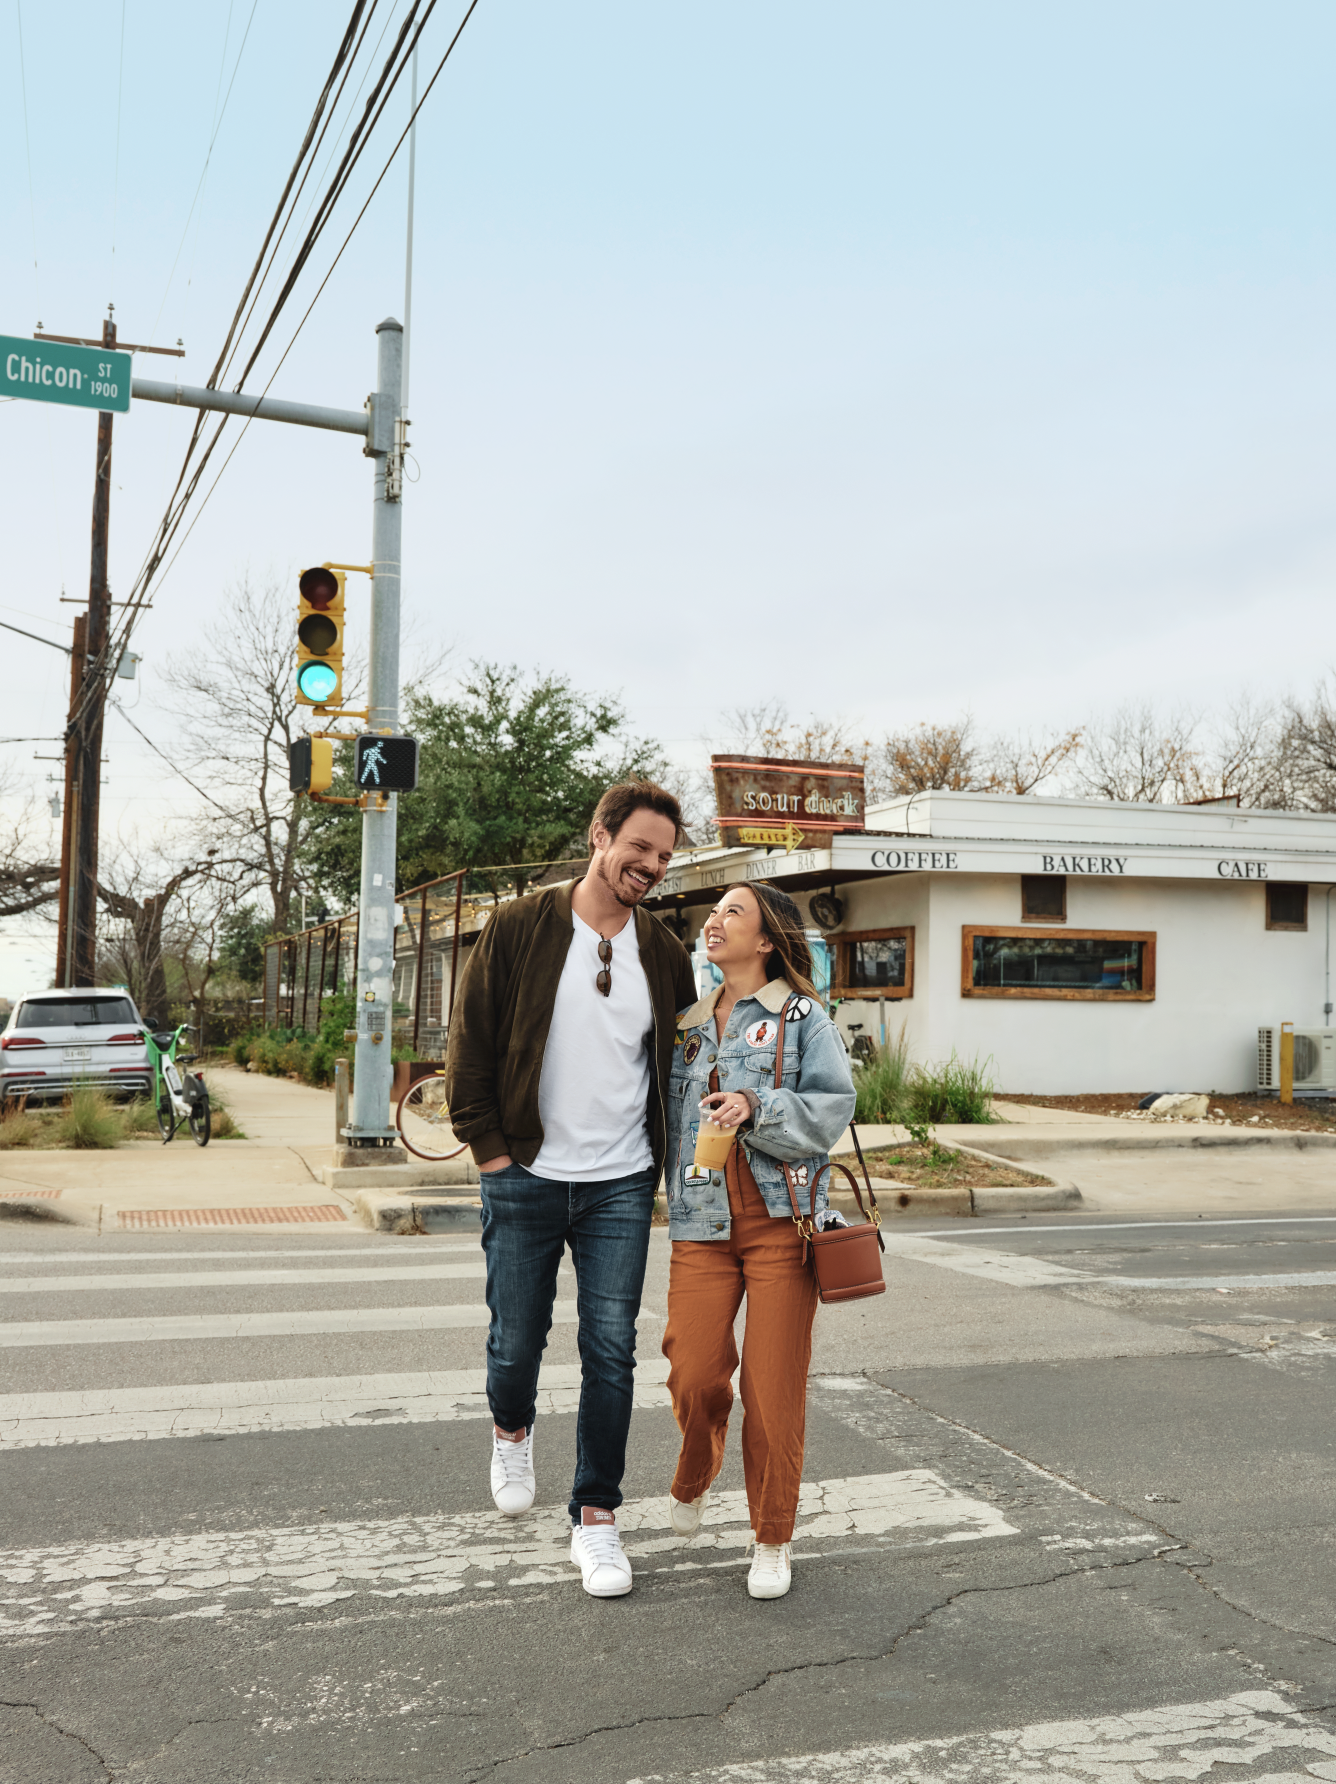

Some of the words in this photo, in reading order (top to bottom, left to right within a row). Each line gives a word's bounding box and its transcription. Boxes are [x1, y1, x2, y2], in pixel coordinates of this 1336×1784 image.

[6, 353, 82, 390] Chicon
[98, 362, 112, 378] ST
[91, 381, 118, 398] 1900
[744, 791, 802, 813] sour
[804, 789, 860, 816] duck
[701, 868, 725, 887] LUNCH
[746, 859, 777, 879] DINNER
[798, 853, 816, 871] BAR
[871, 850, 958, 869] COFFEE
[1042, 855, 1128, 874] BAKERY
[1217, 860, 1268, 879] CAFE
